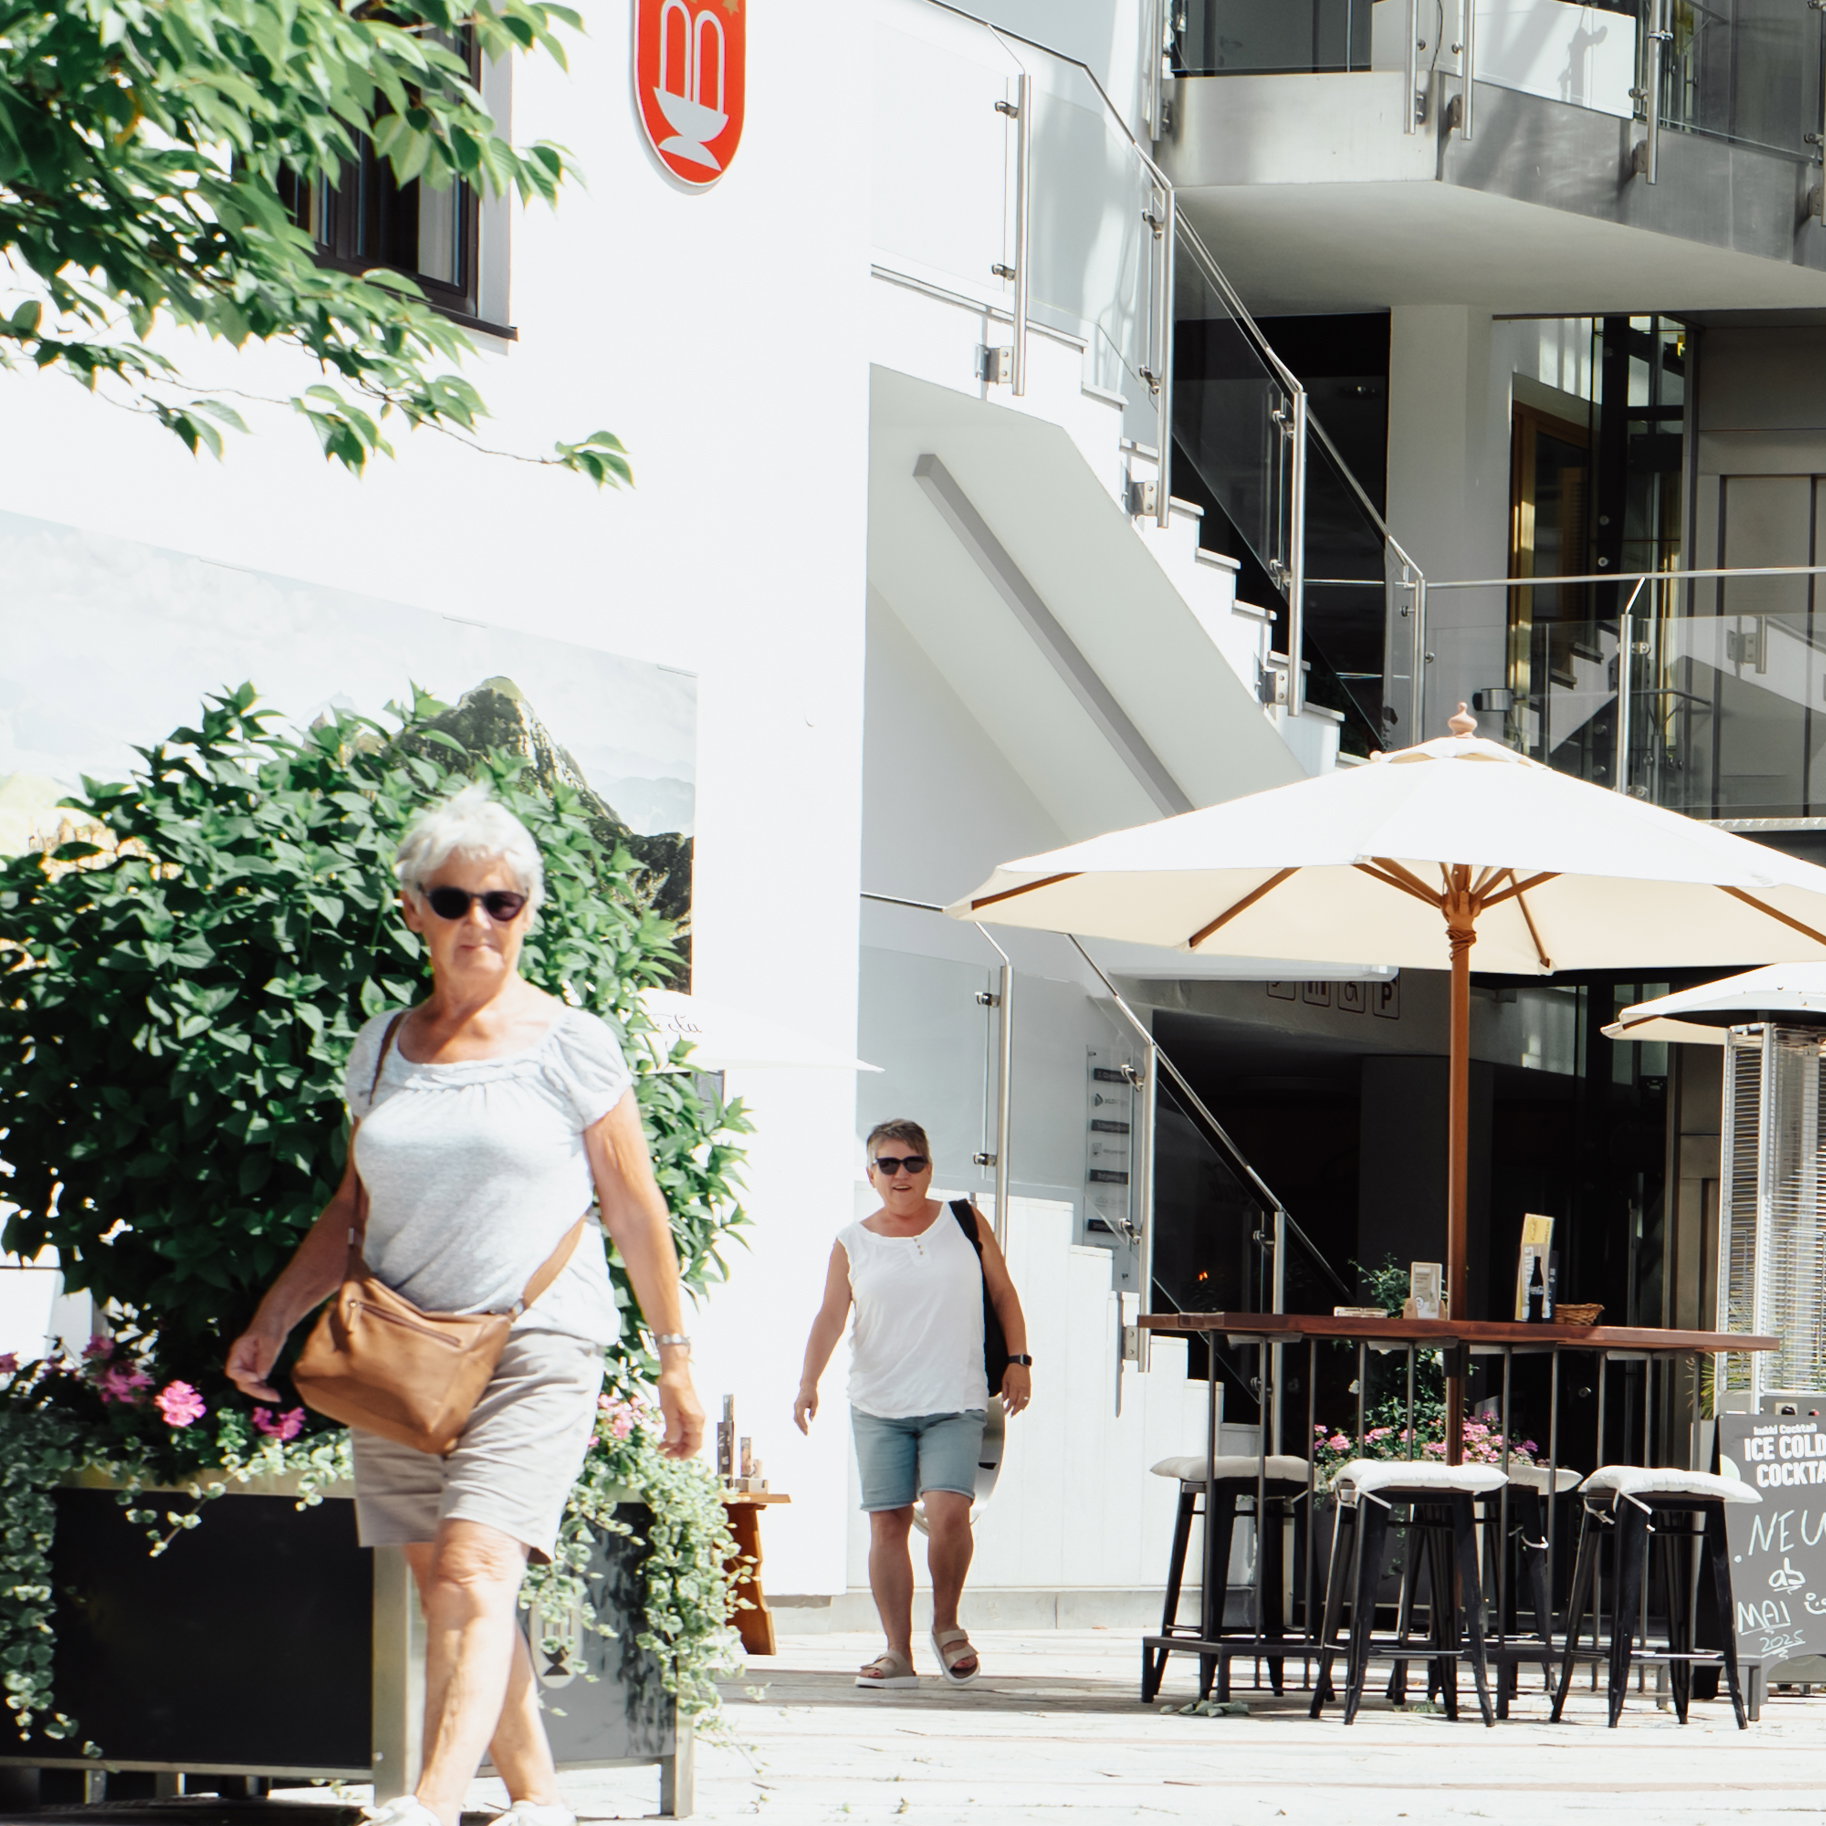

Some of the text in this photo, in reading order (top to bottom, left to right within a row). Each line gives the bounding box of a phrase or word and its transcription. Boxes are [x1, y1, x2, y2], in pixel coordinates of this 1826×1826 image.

[1744, 1436, 1776, 1462] ICE
[1768, 1557, 1807, 1590] ab
[1737, 1600, 1792, 1634] MAI
[1759, 1629, 1806, 1653] 2025
